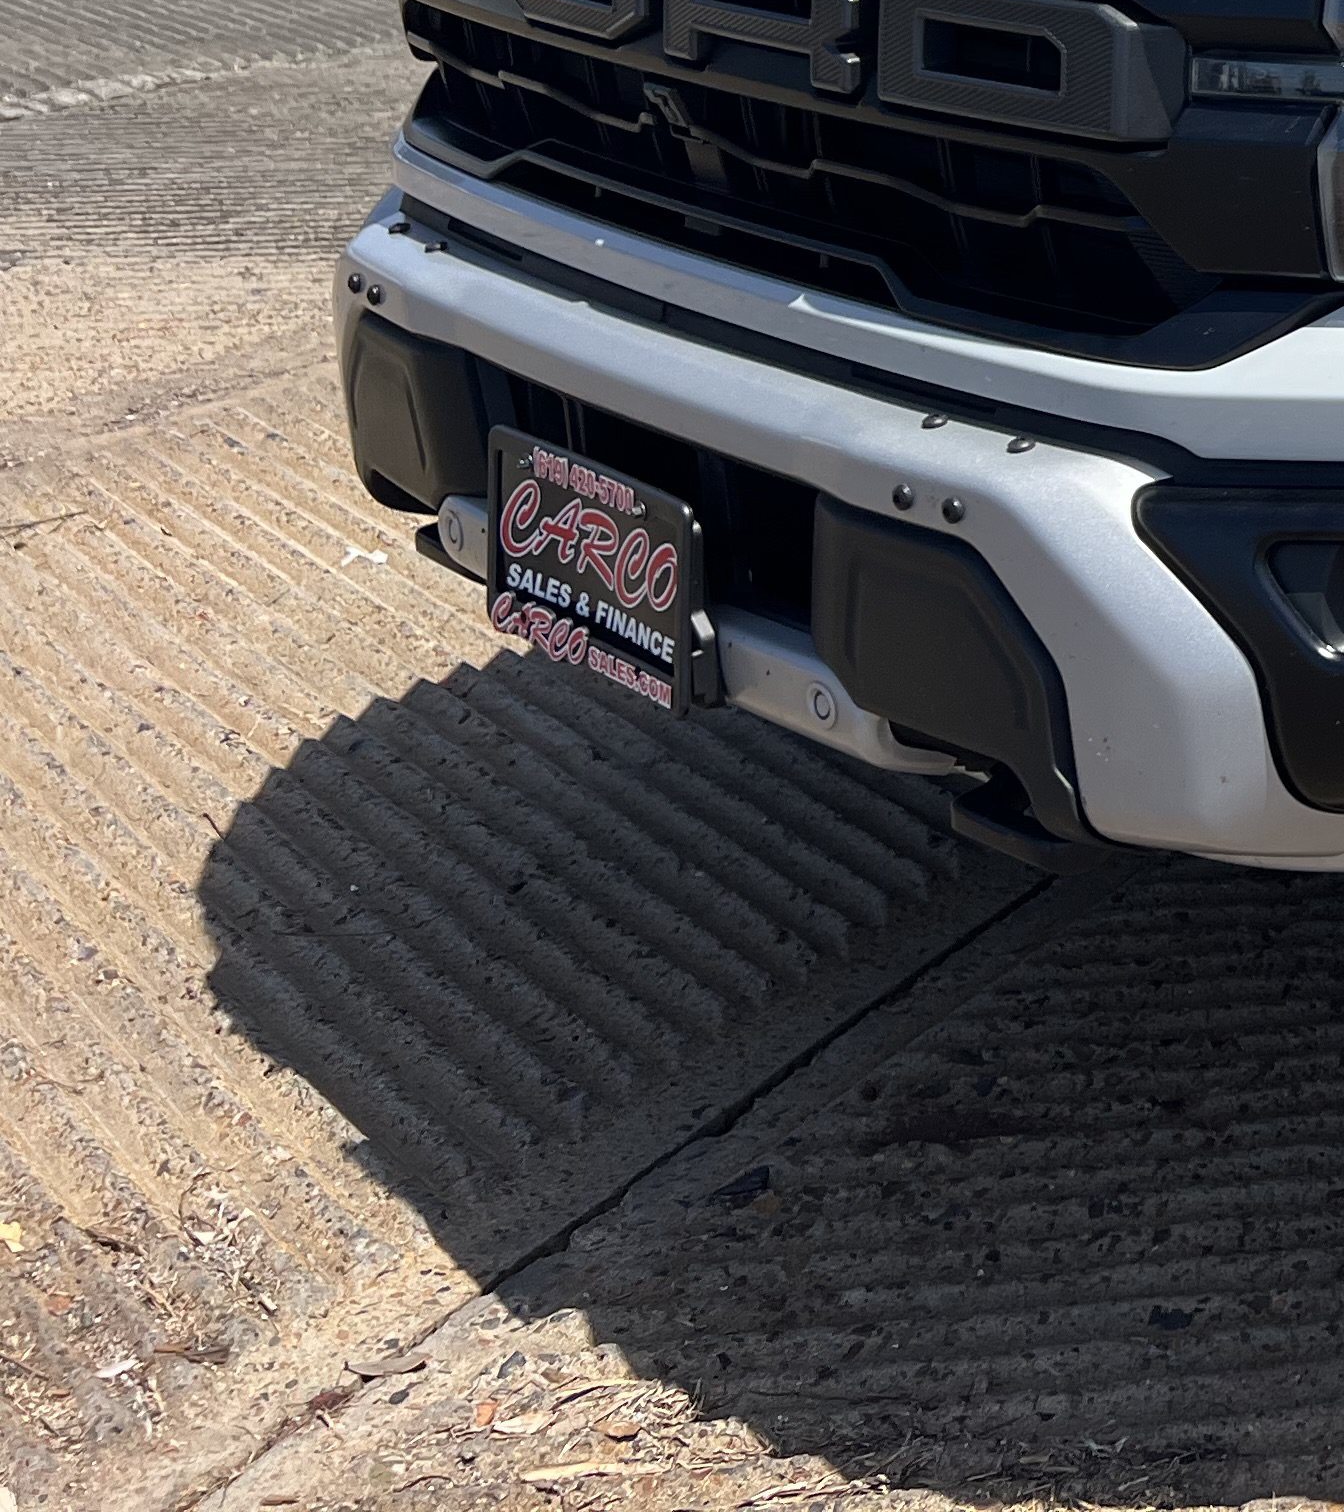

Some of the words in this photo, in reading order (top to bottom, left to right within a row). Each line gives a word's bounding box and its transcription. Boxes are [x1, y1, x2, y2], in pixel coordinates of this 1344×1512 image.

[532, 445, 569, 490] (619)
[569, 463, 635, 516] 420-5700
[500, 478, 678, 612] CARCO
[491, 591, 588, 666] CARCO
[587, 646, 673, 710] SALES.COM
[506, 562, 572, 608] SALES
[575, 591, 591, 617] &
[595, 599, 676, 664] FINANCE
